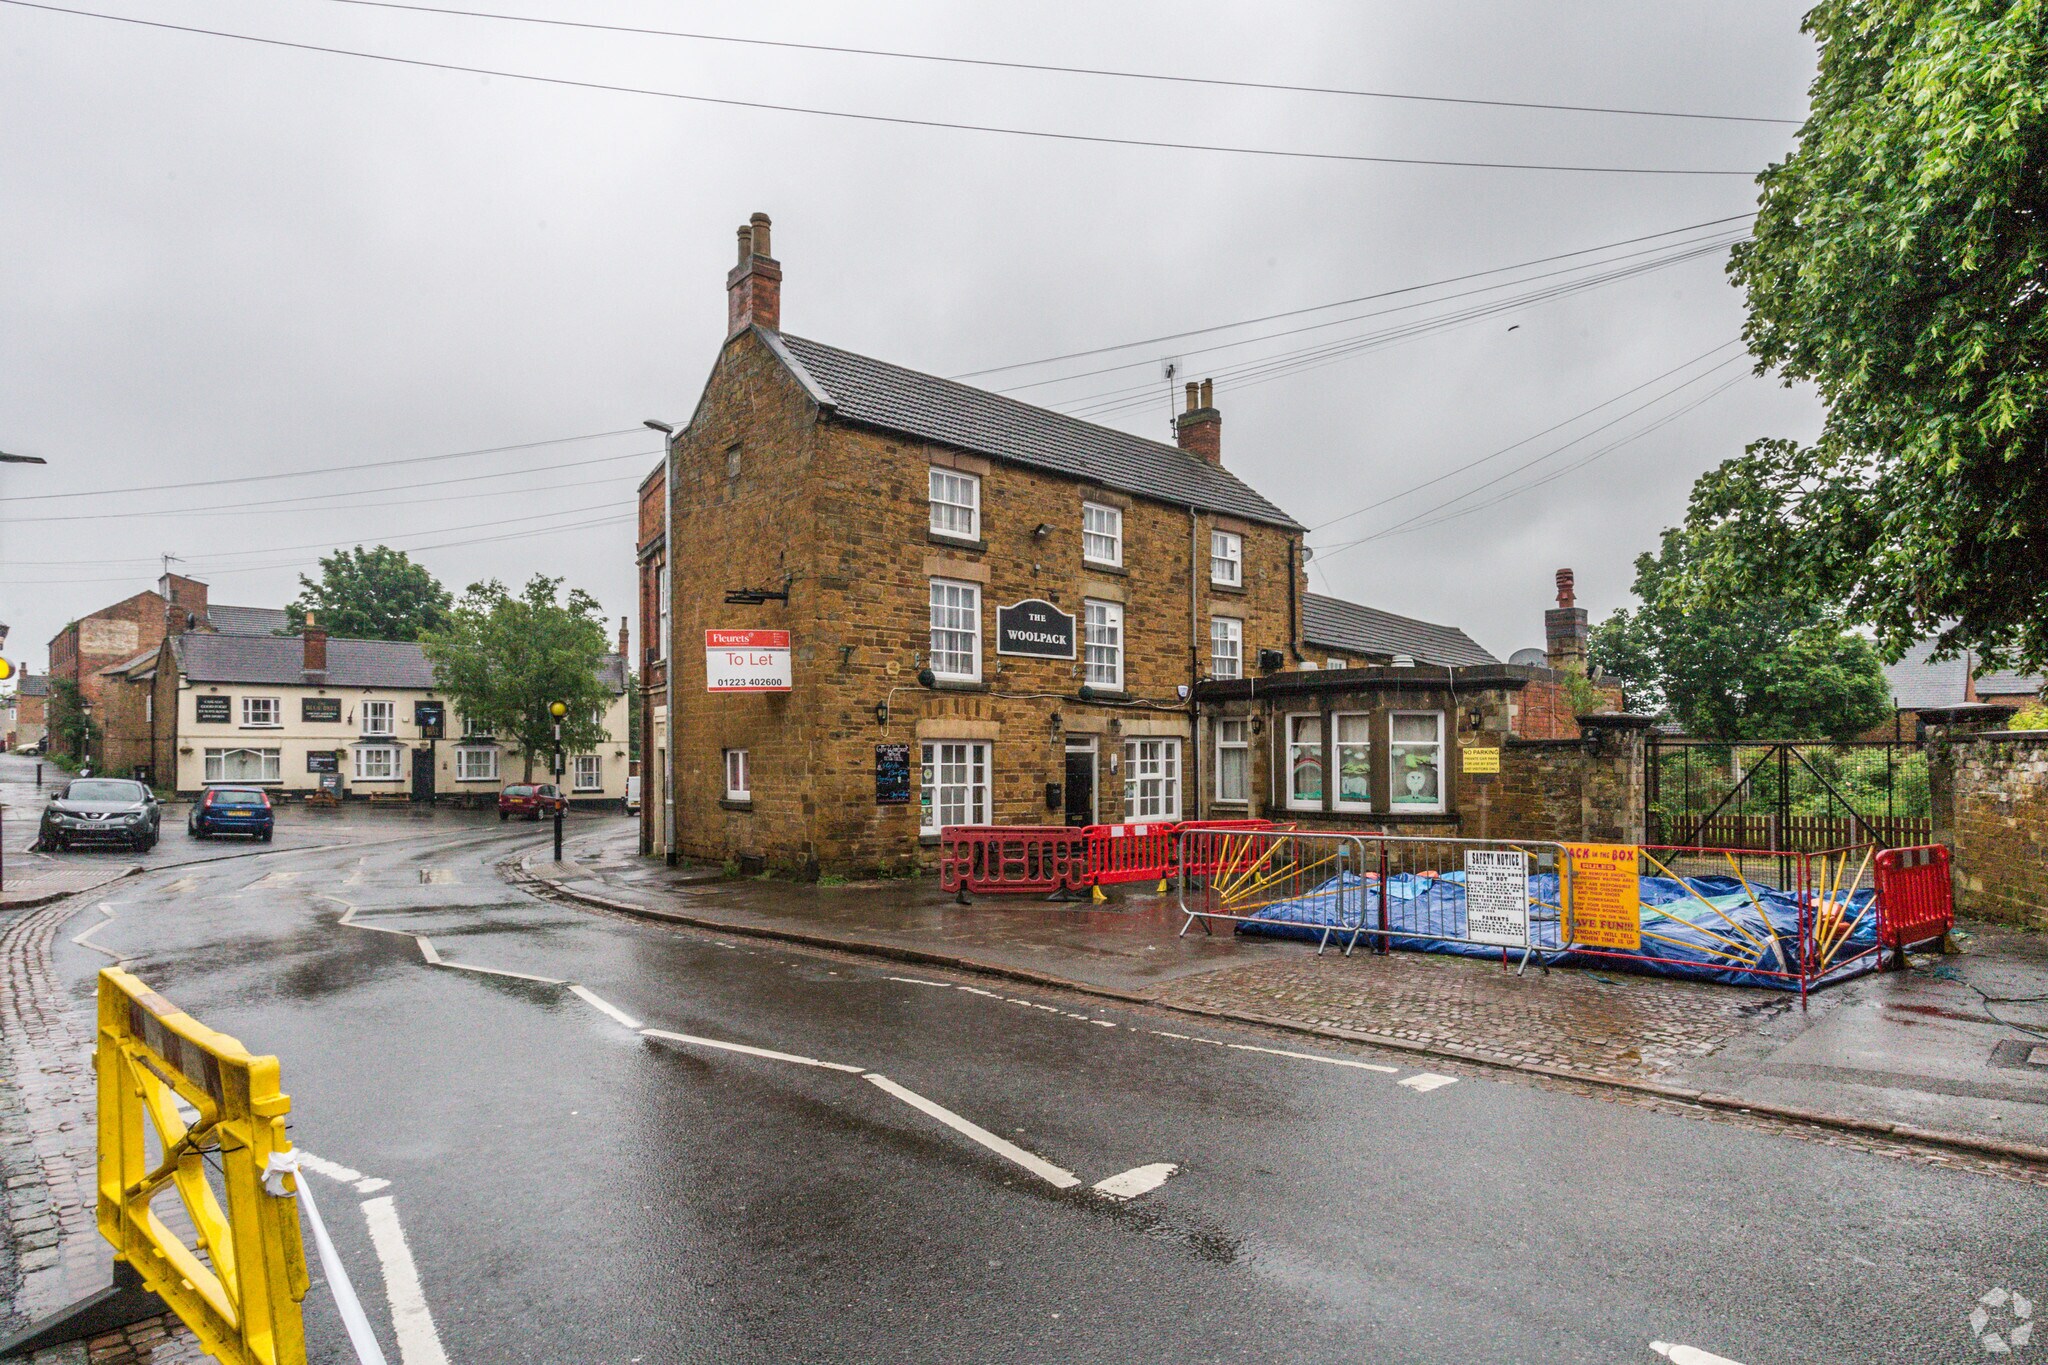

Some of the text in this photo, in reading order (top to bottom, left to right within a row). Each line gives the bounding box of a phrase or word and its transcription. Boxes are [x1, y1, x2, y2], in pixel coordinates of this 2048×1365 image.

[1028, 613, 1047, 622] THE
[713, 633, 750, 643] Fleurets
[1007, 629, 1067, 645] WOOLPACK
[726, 652, 773, 666] To Let
[718, 678, 782, 686] 01223 402600
[1472, 853, 1519, 866] SAFETY NOTICE
[1612, 849, 1634, 861] BOX
